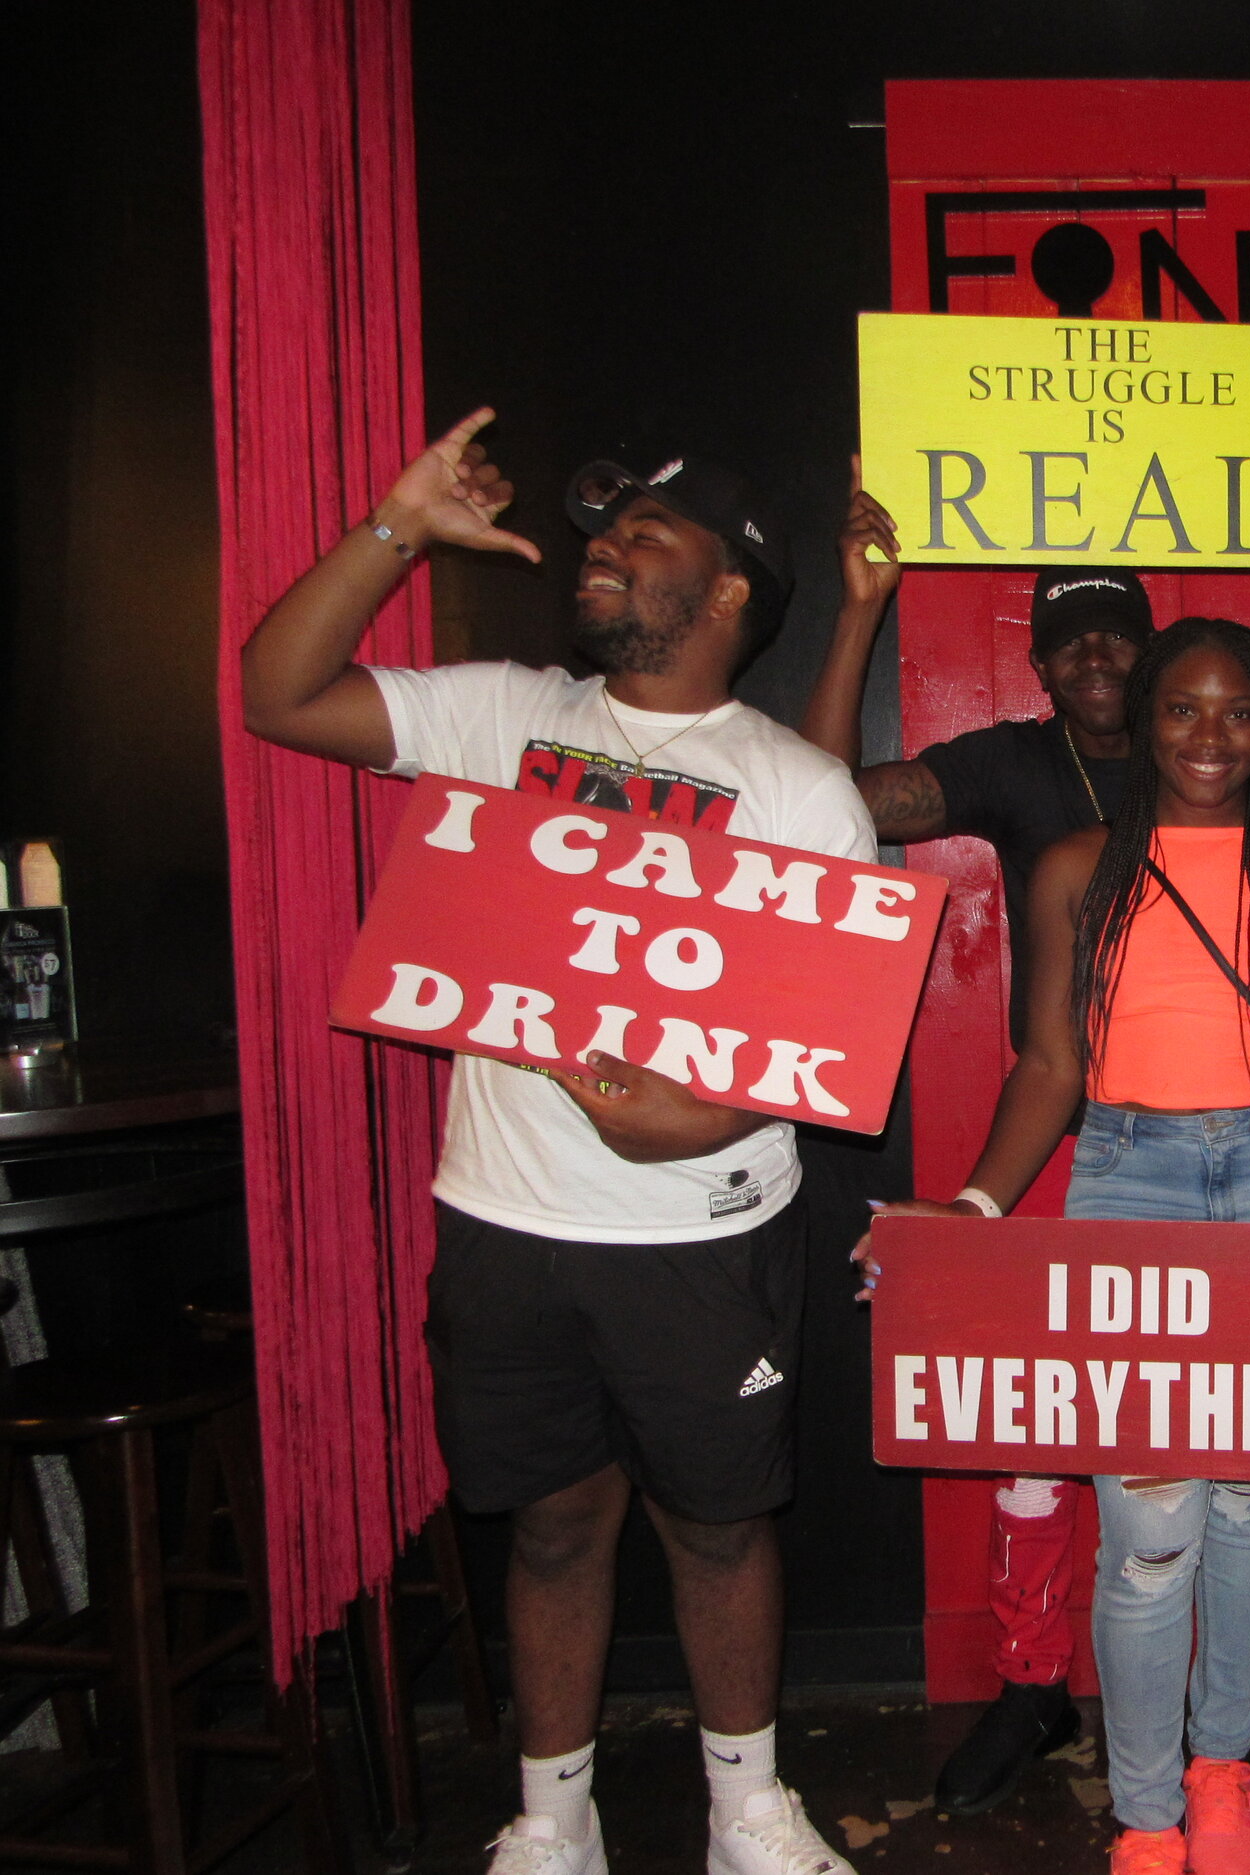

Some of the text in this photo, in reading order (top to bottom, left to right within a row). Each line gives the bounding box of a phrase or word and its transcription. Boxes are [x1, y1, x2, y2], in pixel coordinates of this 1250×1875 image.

[1053, 326, 1152, 364] THE
[968, 364, 1238, 407] STRUGGLE
[1084, 408, 1126, 445] IS
[1046, 578, 1127, 600] Champion
[564, 749, 593, 762] YOUR
[620, 764, 679, 782] Baetball
[681, 776, 736, 799] Magazine
[424, 790, 917, 942] I CAME
[568, 906, 724, 991] TO
[370, 962, 851, 1117] DRINK
[1048, 1262, 1211, 1336] I DID
[739, 1371, 784, 1397] adidas
